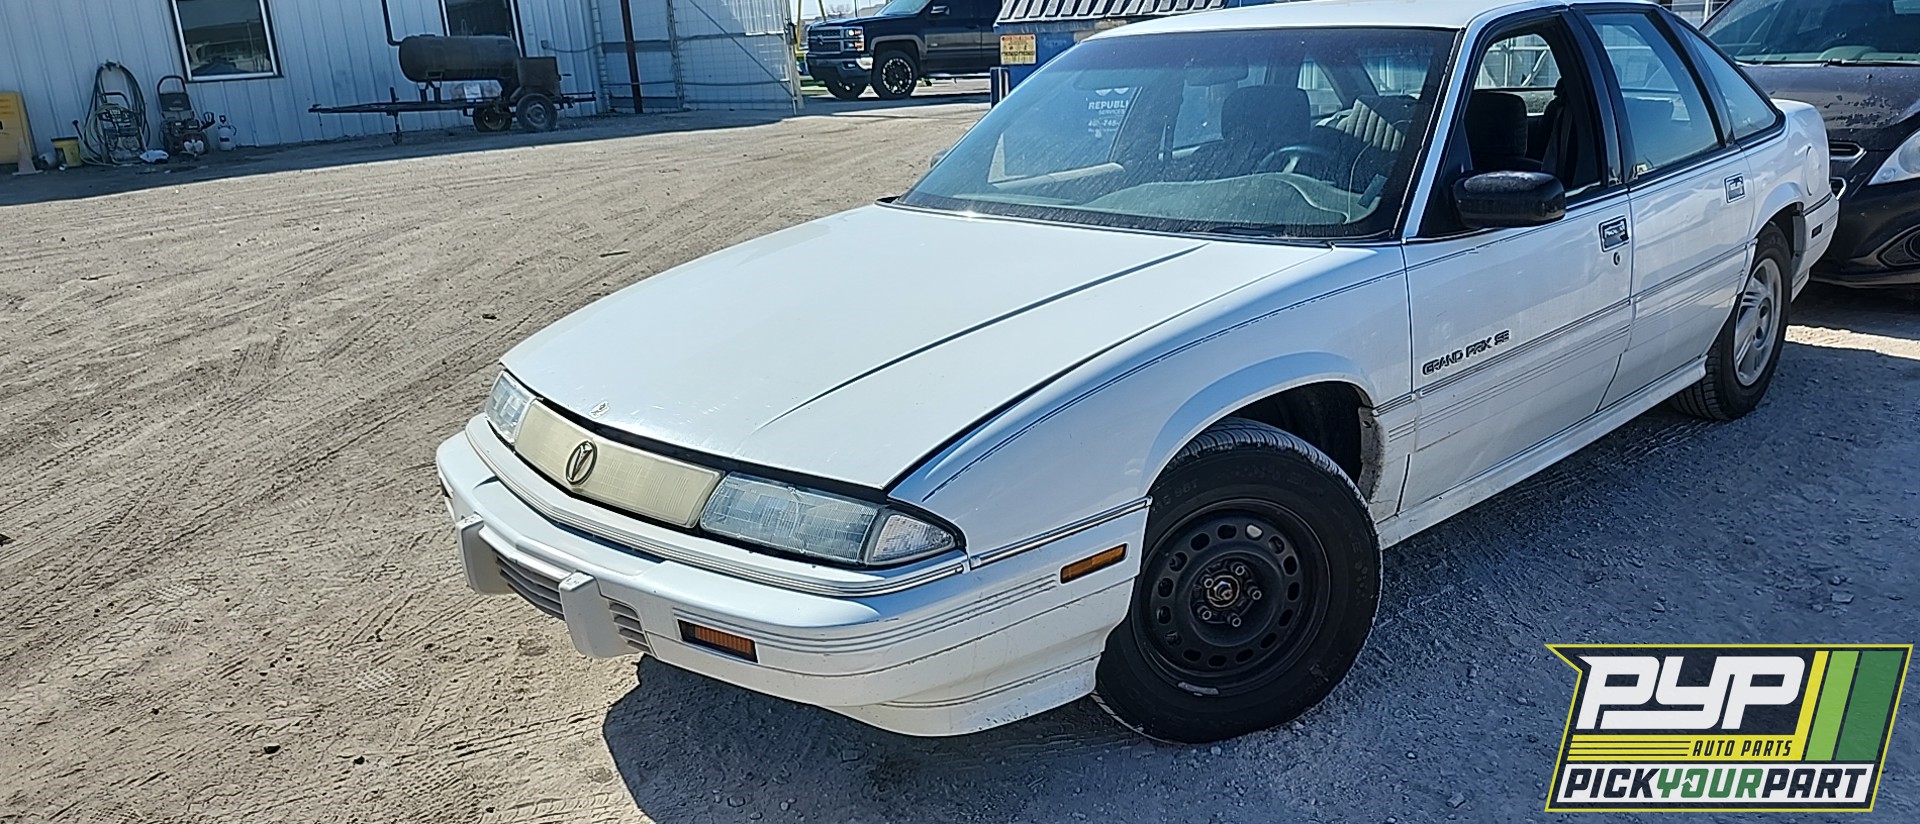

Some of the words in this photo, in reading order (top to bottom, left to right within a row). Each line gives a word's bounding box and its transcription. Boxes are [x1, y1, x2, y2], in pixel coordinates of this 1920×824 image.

[1088, 100, 1129, 110] REPUBLI
[1422, 349, 1464, 375] GRAND
[1465, 336, 1493, 358] PRIX
[1494, 329, 1510, 346] SE
